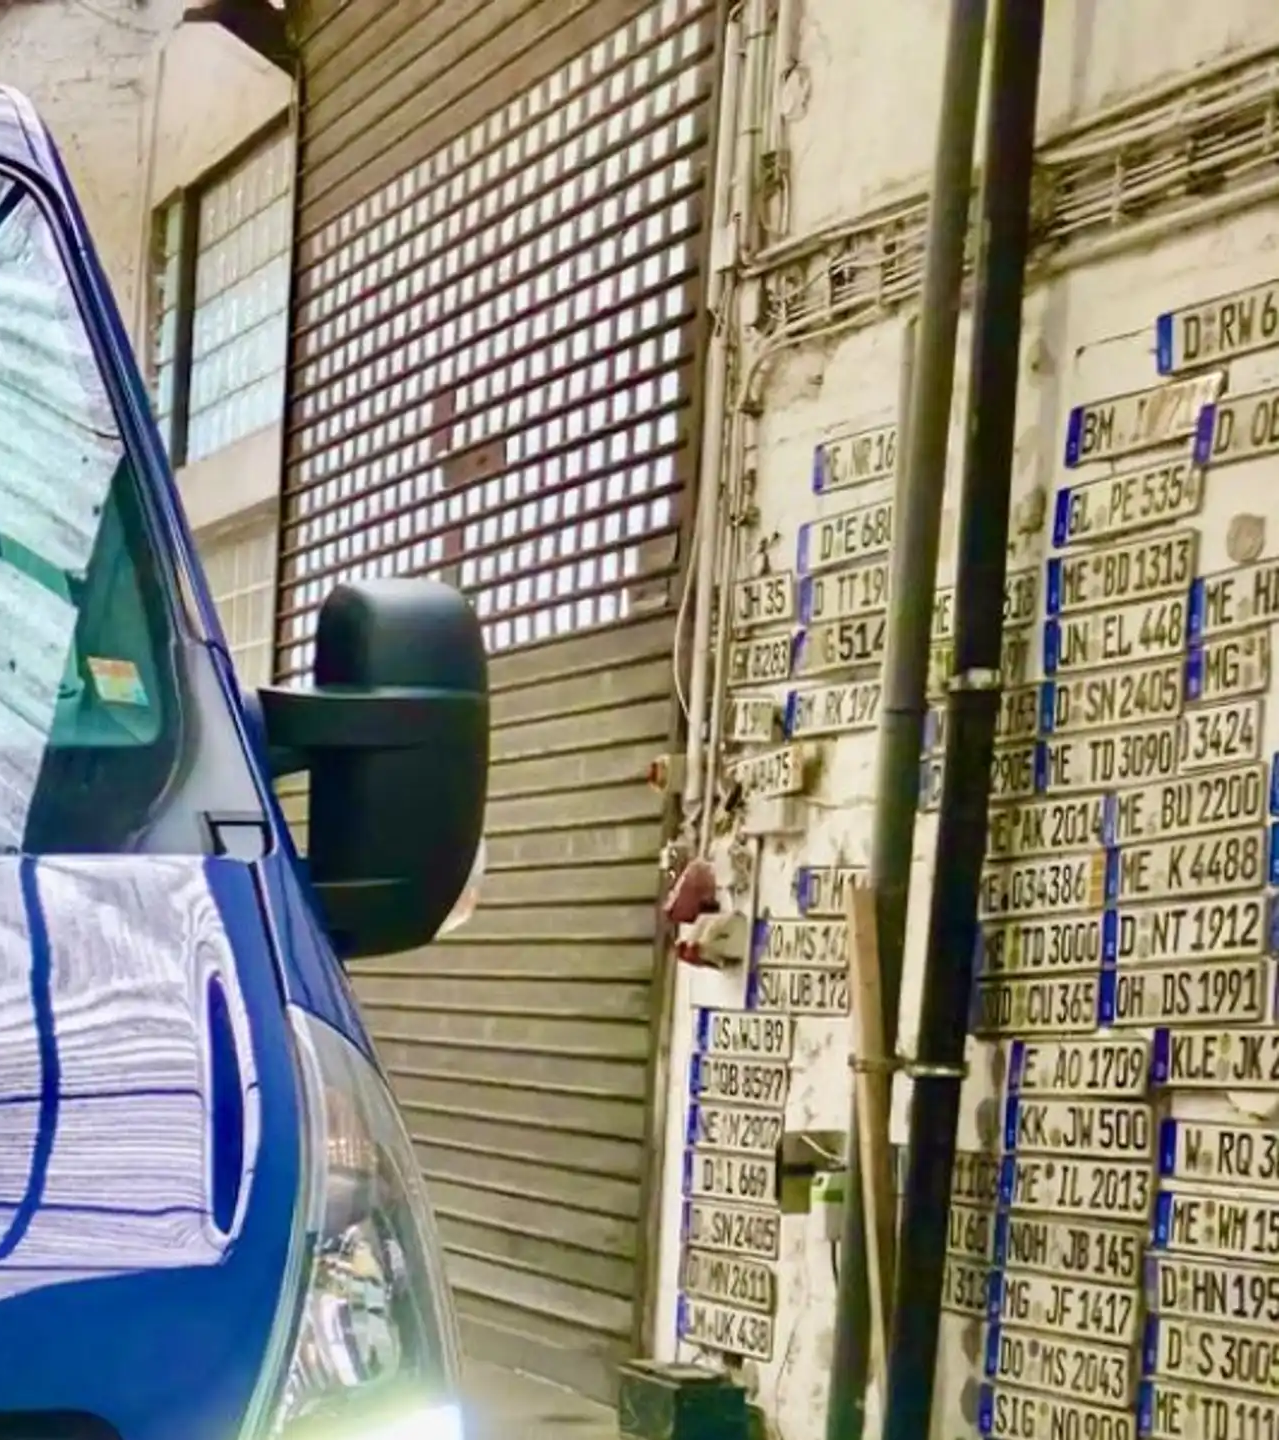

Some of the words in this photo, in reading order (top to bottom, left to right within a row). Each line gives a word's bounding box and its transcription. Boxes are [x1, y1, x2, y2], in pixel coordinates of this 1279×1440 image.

[1109, 477, 1136, 526] PE
[1133, 539, 1190, 593] 1313
[765, 579, 786, 615] 35
[1103, 615, 1132, 659] EL
[1140, 602, 1182, 650] 448
[1085, 675, 1116, 723] SN
[1120, 668, 1179, 719] 2405
[1195, 708, 1255, 757] 3424
[1089, 738, 1118, 783] TD
[1119, 731, 1171, 778] 3090
[1198, 771, 1259, 822] 2200
[1051, 803, 1103, 847] 2014
[1169, 846, 1186, 889] K
[1190, 836, 1259, 883] 4488
[1051, 921, 1100, 965] 3000
[1152, 910, 1186, 956] NT
[1190, 902, 1259, 951] 1912
[818, 972, 847, 1009] 172
[1056, 983, 1095, 1025] 365
[1196, 967, 1259, 1013] 1991
[1087, 1047, 1143, 1089] 1709
[1171, 1035, 1217, 1079] KLE
[1233, 1035, 1263, 1080] JK
[742, 1065, 784, 1102] 8597
[1099, 1108, 1148, 1152] 500
[1219, 1131, 1253, 1177] RQ
[1091, 1167, 1149, 1212] 2013
[735, 1214, 775, 1253] 2405
[1095, 1232, 1135, 1278] 145
[732, 1264, 767, 1304] 2611
[1162, 1267, 1177, 1308] D
[1193, 1268, 1226, 1315] HN
[738, 1313, 770, 1354] 438
[1046, 1286, 1073, 1326] JF
[1077, 1290, 1132, 1335] 1417
[1166, 1327, 1181, 1369] D
[1072, 1348, 1124, 1400] 2043
[996, 1394, 1036, 1440] SIG
